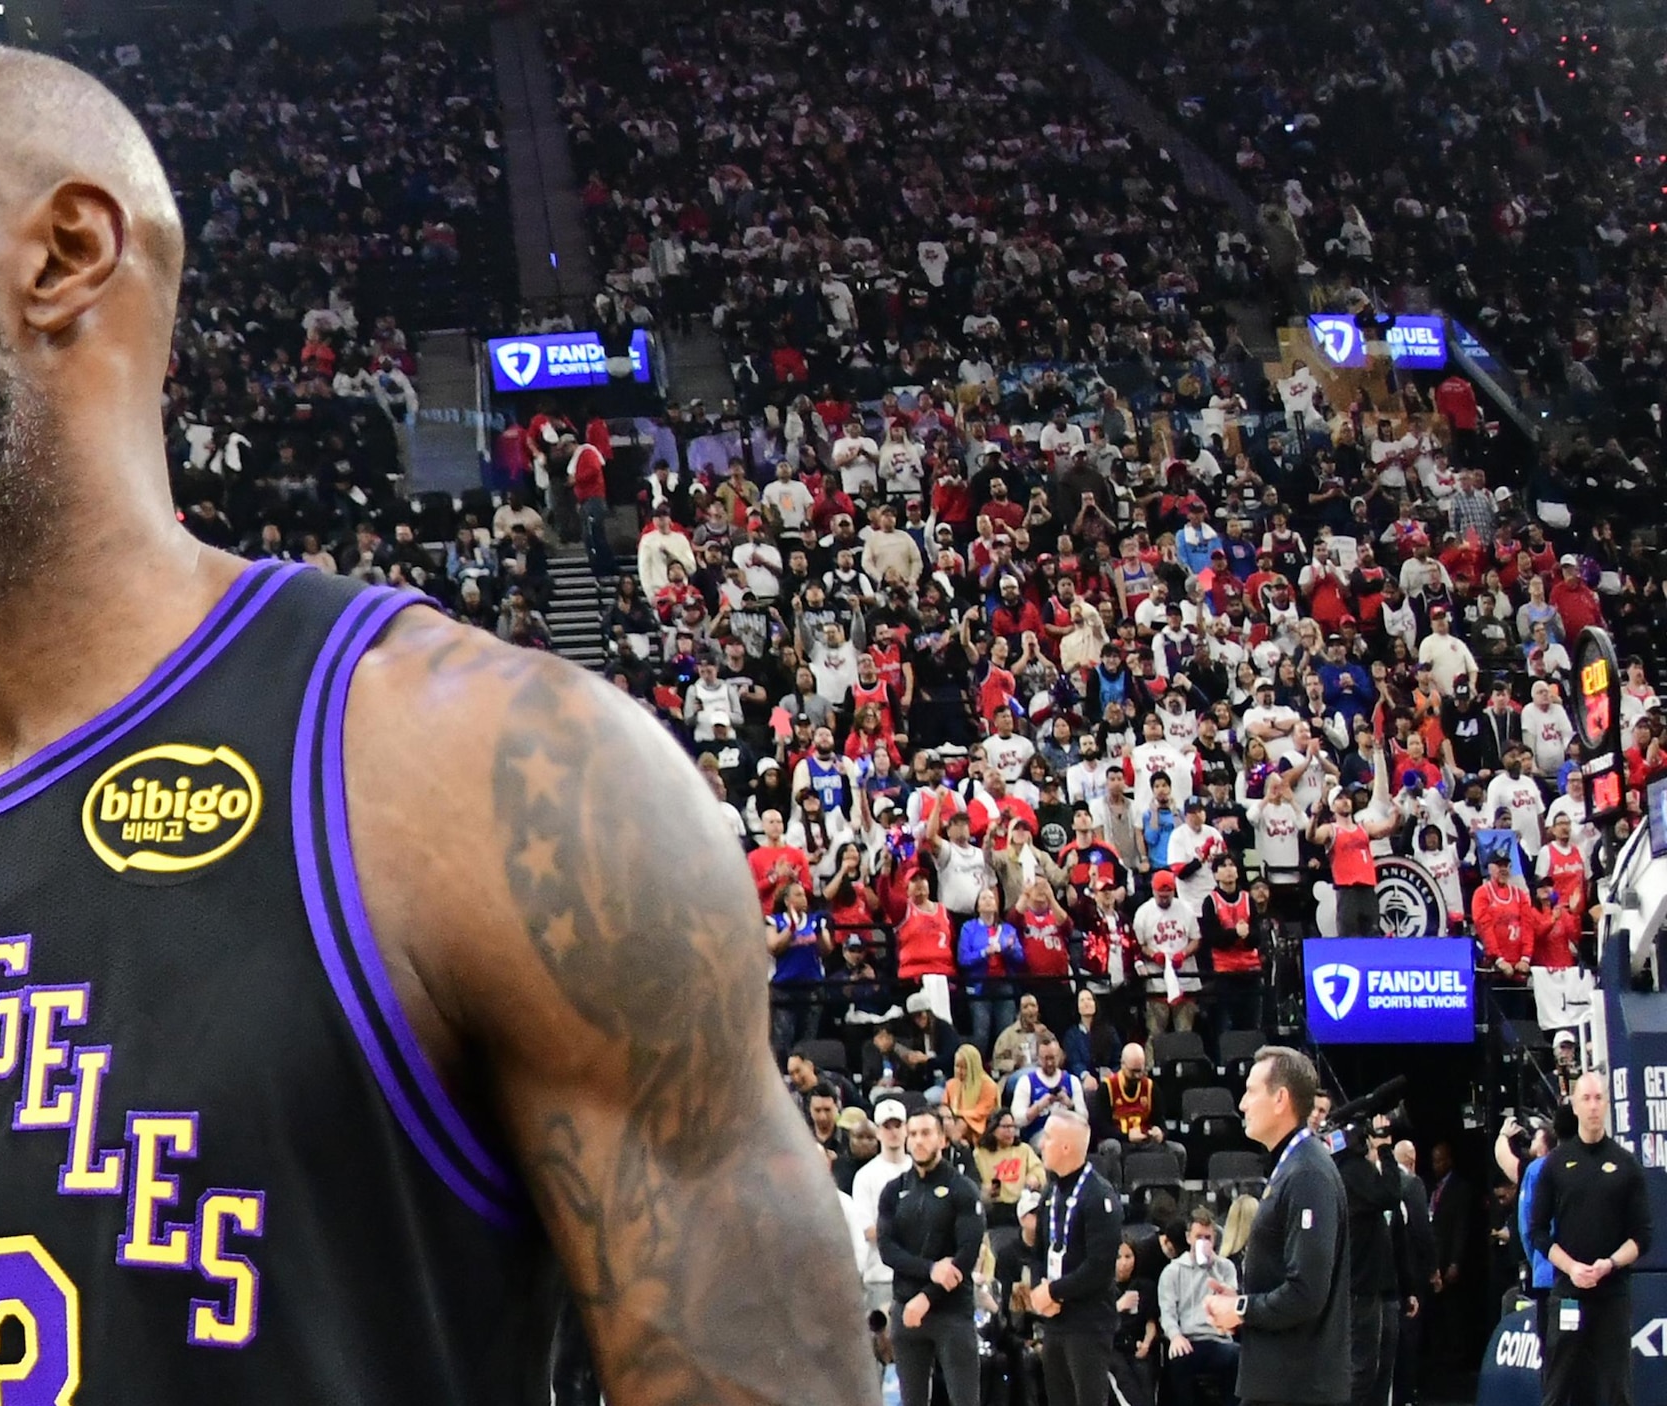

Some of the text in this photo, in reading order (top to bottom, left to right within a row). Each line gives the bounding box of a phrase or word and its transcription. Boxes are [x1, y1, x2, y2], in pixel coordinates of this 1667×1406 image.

[100, 776, 250, 834] bibigo
[121, 821, 185, 843] 비비고
[1156, 920, 1178, 933] GET
[938, 932, 948, 949] 2
[1367, 970, 1467, 993] FANDUEL
[1368, 995, 1467, 1009] SPORTS NETWORK
[1646, 1100, 1667, 1131] TH
